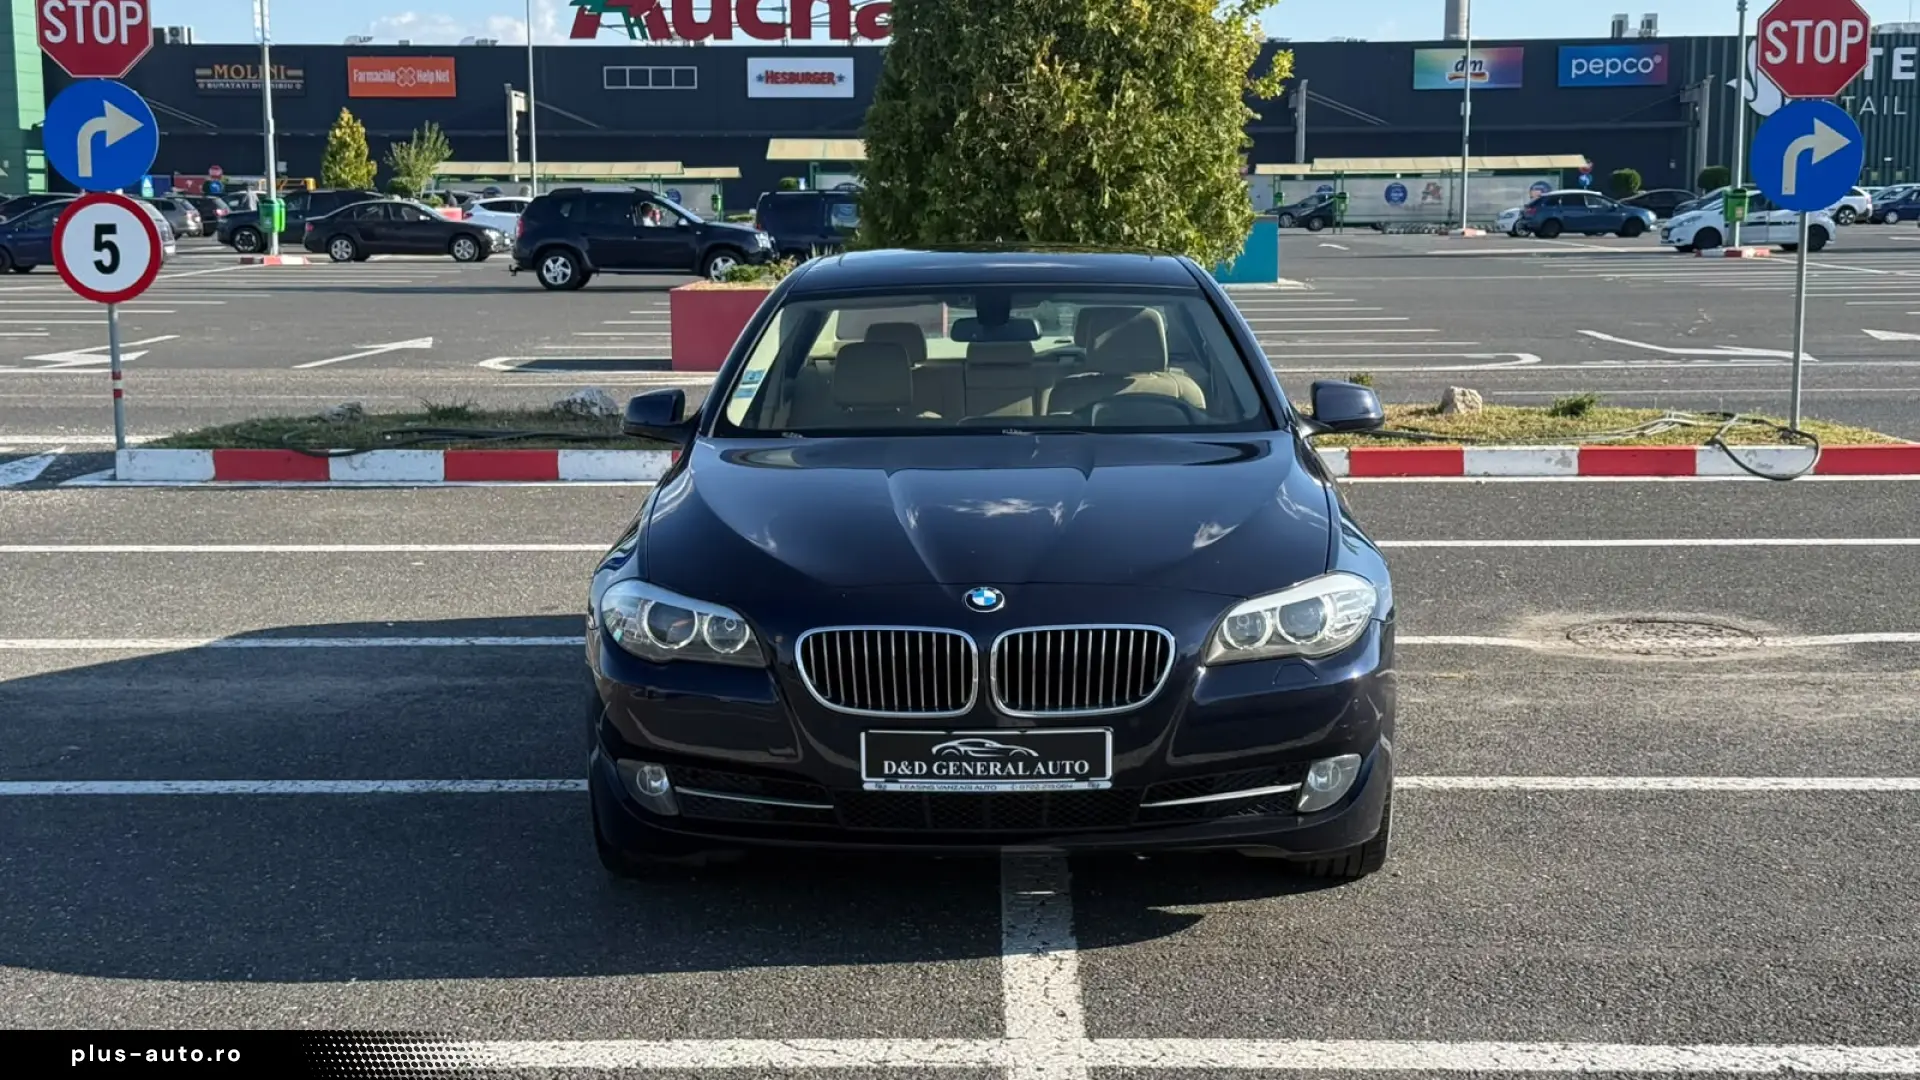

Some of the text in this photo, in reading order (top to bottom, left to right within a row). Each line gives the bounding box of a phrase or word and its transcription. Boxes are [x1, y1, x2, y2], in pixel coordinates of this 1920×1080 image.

[43, 0, 144, 45] STOP
[1764, 19, 1864, 65] STOP
[213, 64, 286, 79] MOLINI
[1454, 55, 1483, 72] dm
[353, 68, 396, 83] Farmaciile
[416, 69, 435, 84] Help
[764, 70, 836, 86] HESBURGER
[93, 223, 120, 275] 5
[883, 760, 1090, 775] D&D GENERAL AUTO
